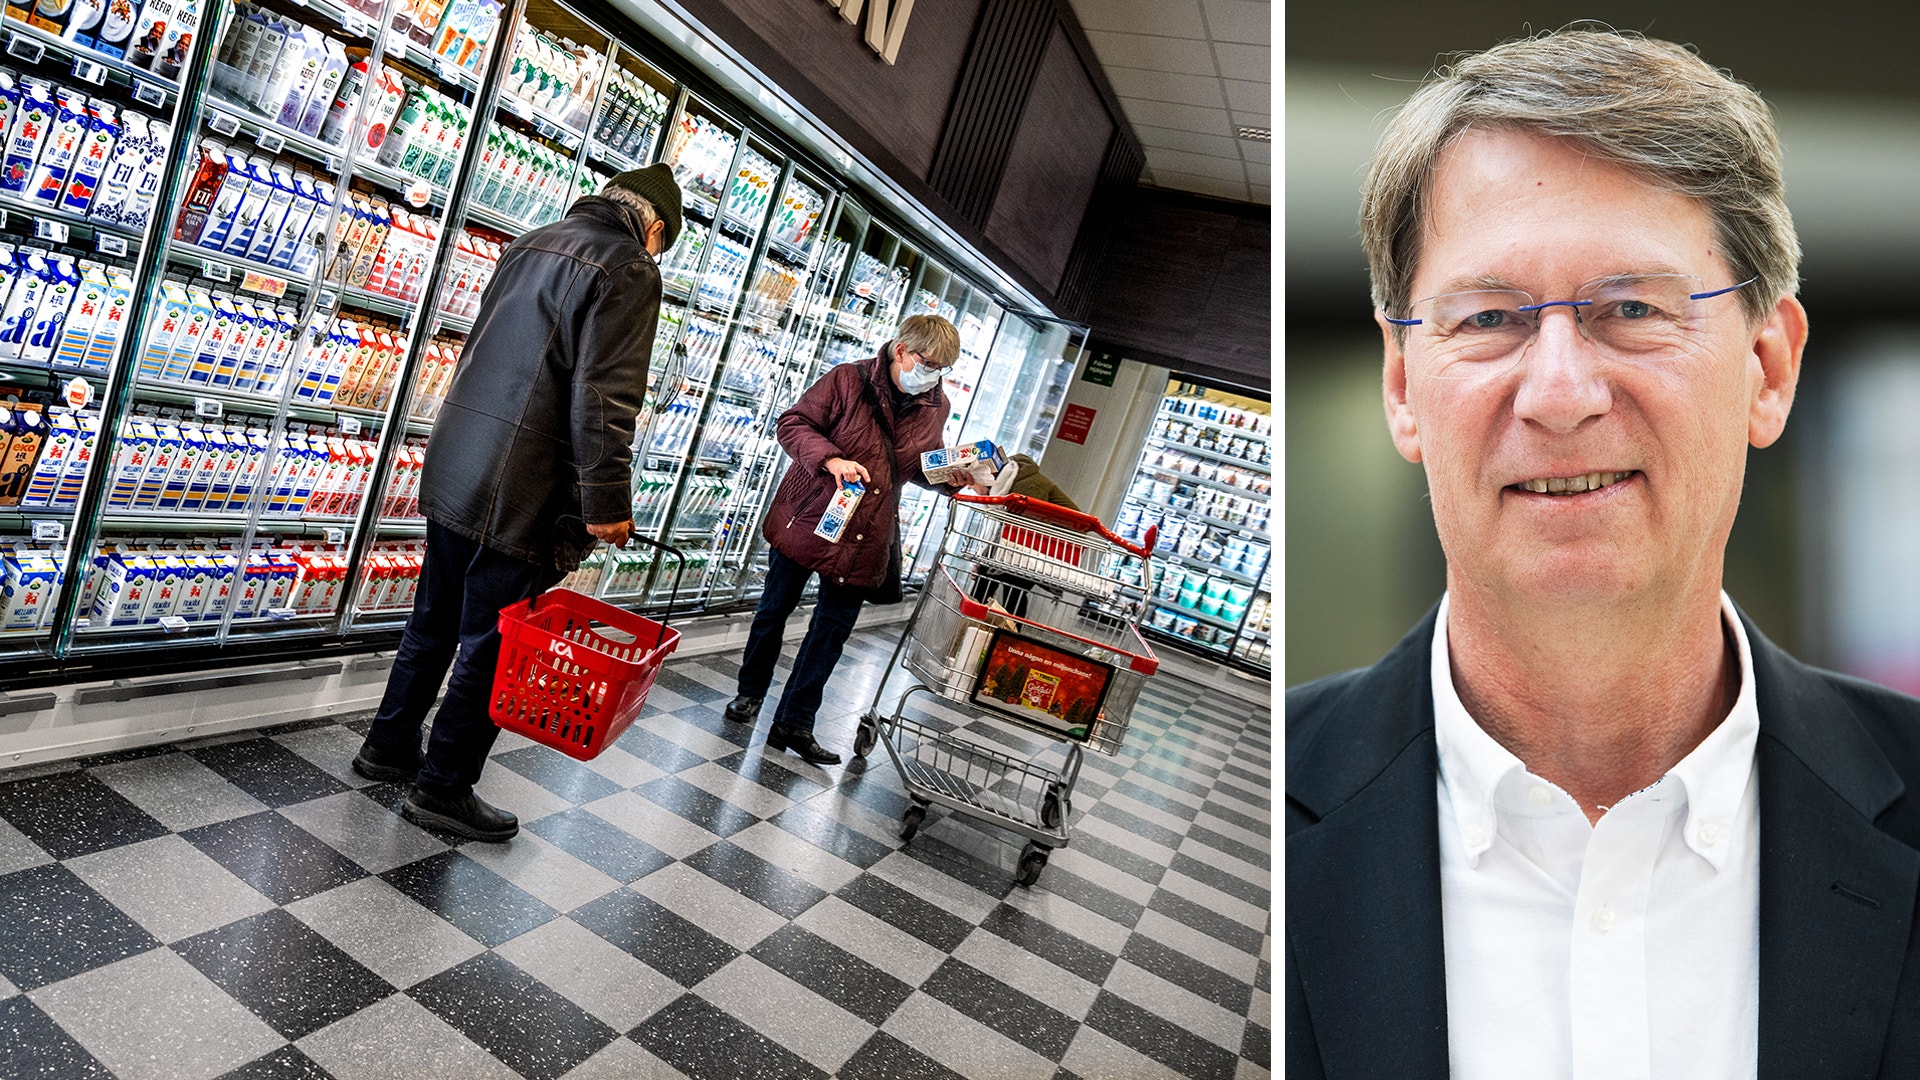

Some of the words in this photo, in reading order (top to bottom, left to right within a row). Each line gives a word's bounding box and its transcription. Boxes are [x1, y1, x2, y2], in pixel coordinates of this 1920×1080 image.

[112, 163, 134, 184] Fil
[193, 189, 212, 207] FIL
[13, 443, 36, 453] eko
[549, 639, 574, 660] ICA
[1008, 646, 1024, 657] Unna
